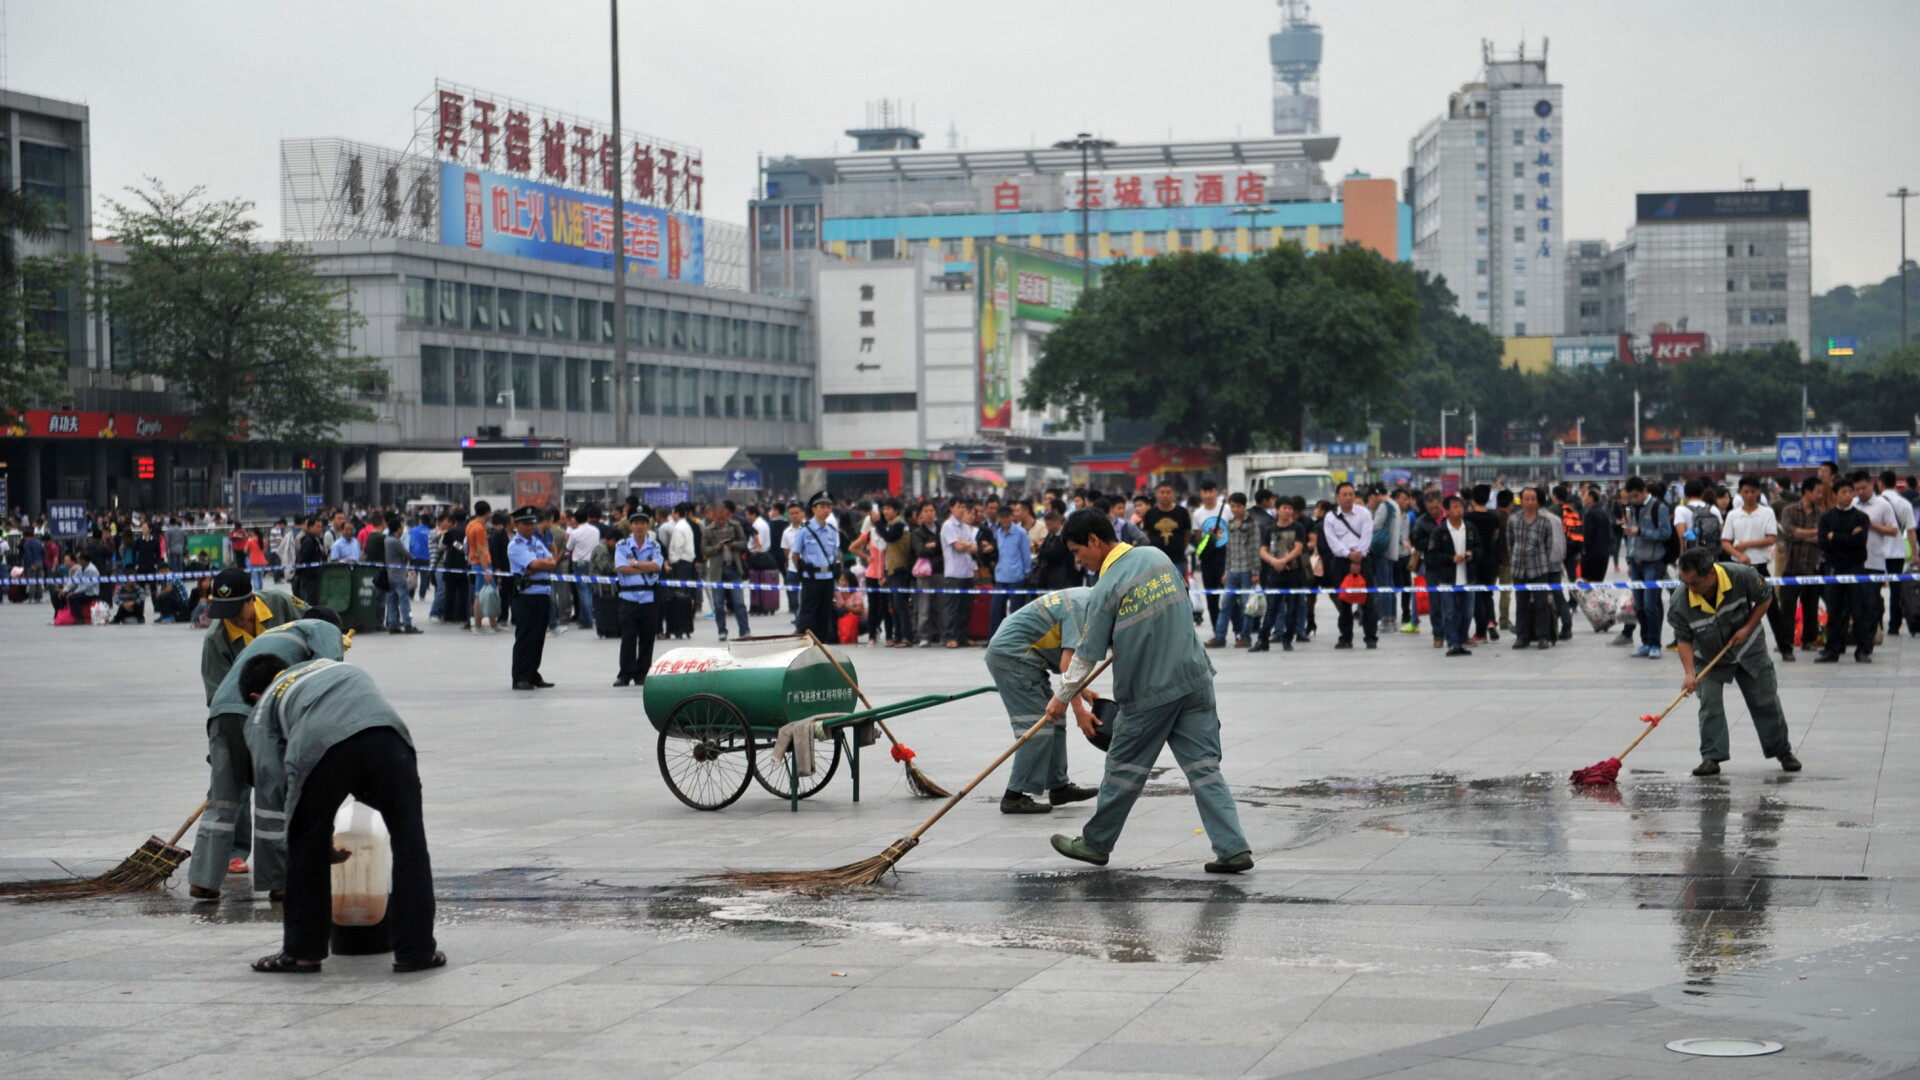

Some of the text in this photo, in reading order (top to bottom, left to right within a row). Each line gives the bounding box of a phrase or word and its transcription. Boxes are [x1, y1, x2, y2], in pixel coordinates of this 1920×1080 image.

[994, 171, 1265, 211] 白云城市酒店
[1656, 342, 1699, 359] KFC
[48, 414, 79, 433] 真功夫
[1119, 603, 1138, 616] City
[654, 659, 711, 674] 作业中心
